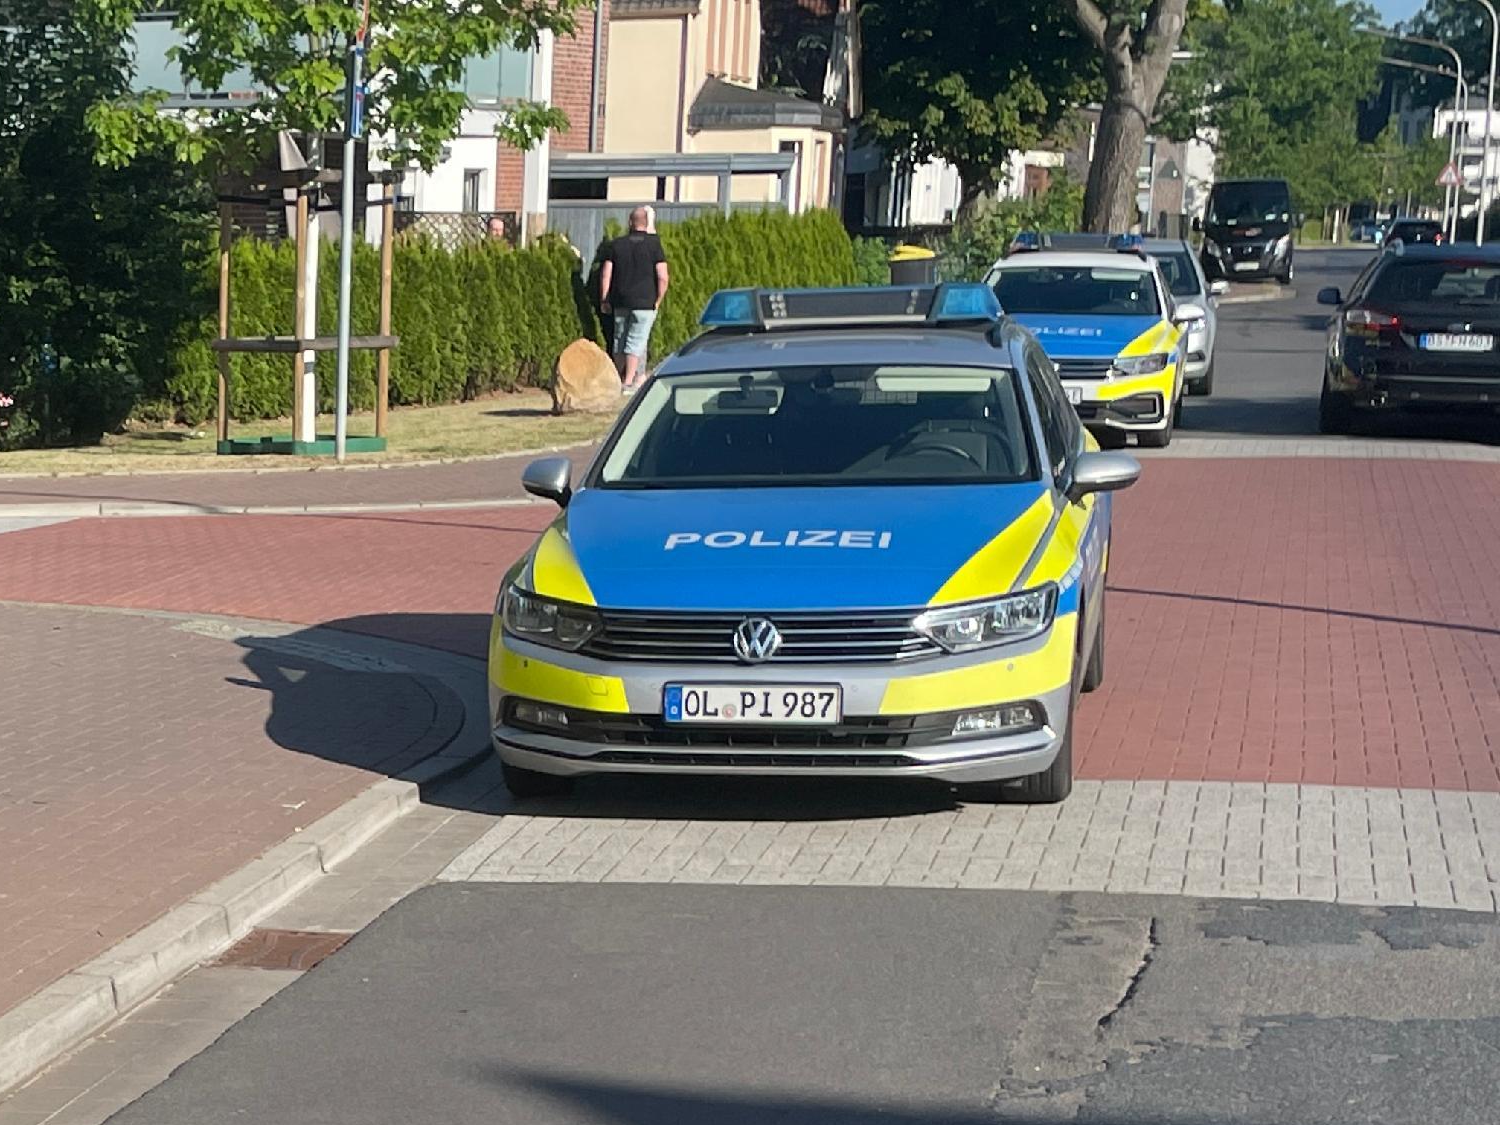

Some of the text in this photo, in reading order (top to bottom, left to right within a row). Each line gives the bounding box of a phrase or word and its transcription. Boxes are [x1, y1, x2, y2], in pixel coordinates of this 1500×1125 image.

[1028, 326, 1102, 337] OLIZEI
[664, 530, 892, 551] POLIZEI
[684, 690, 835, 718] OL PI 987
